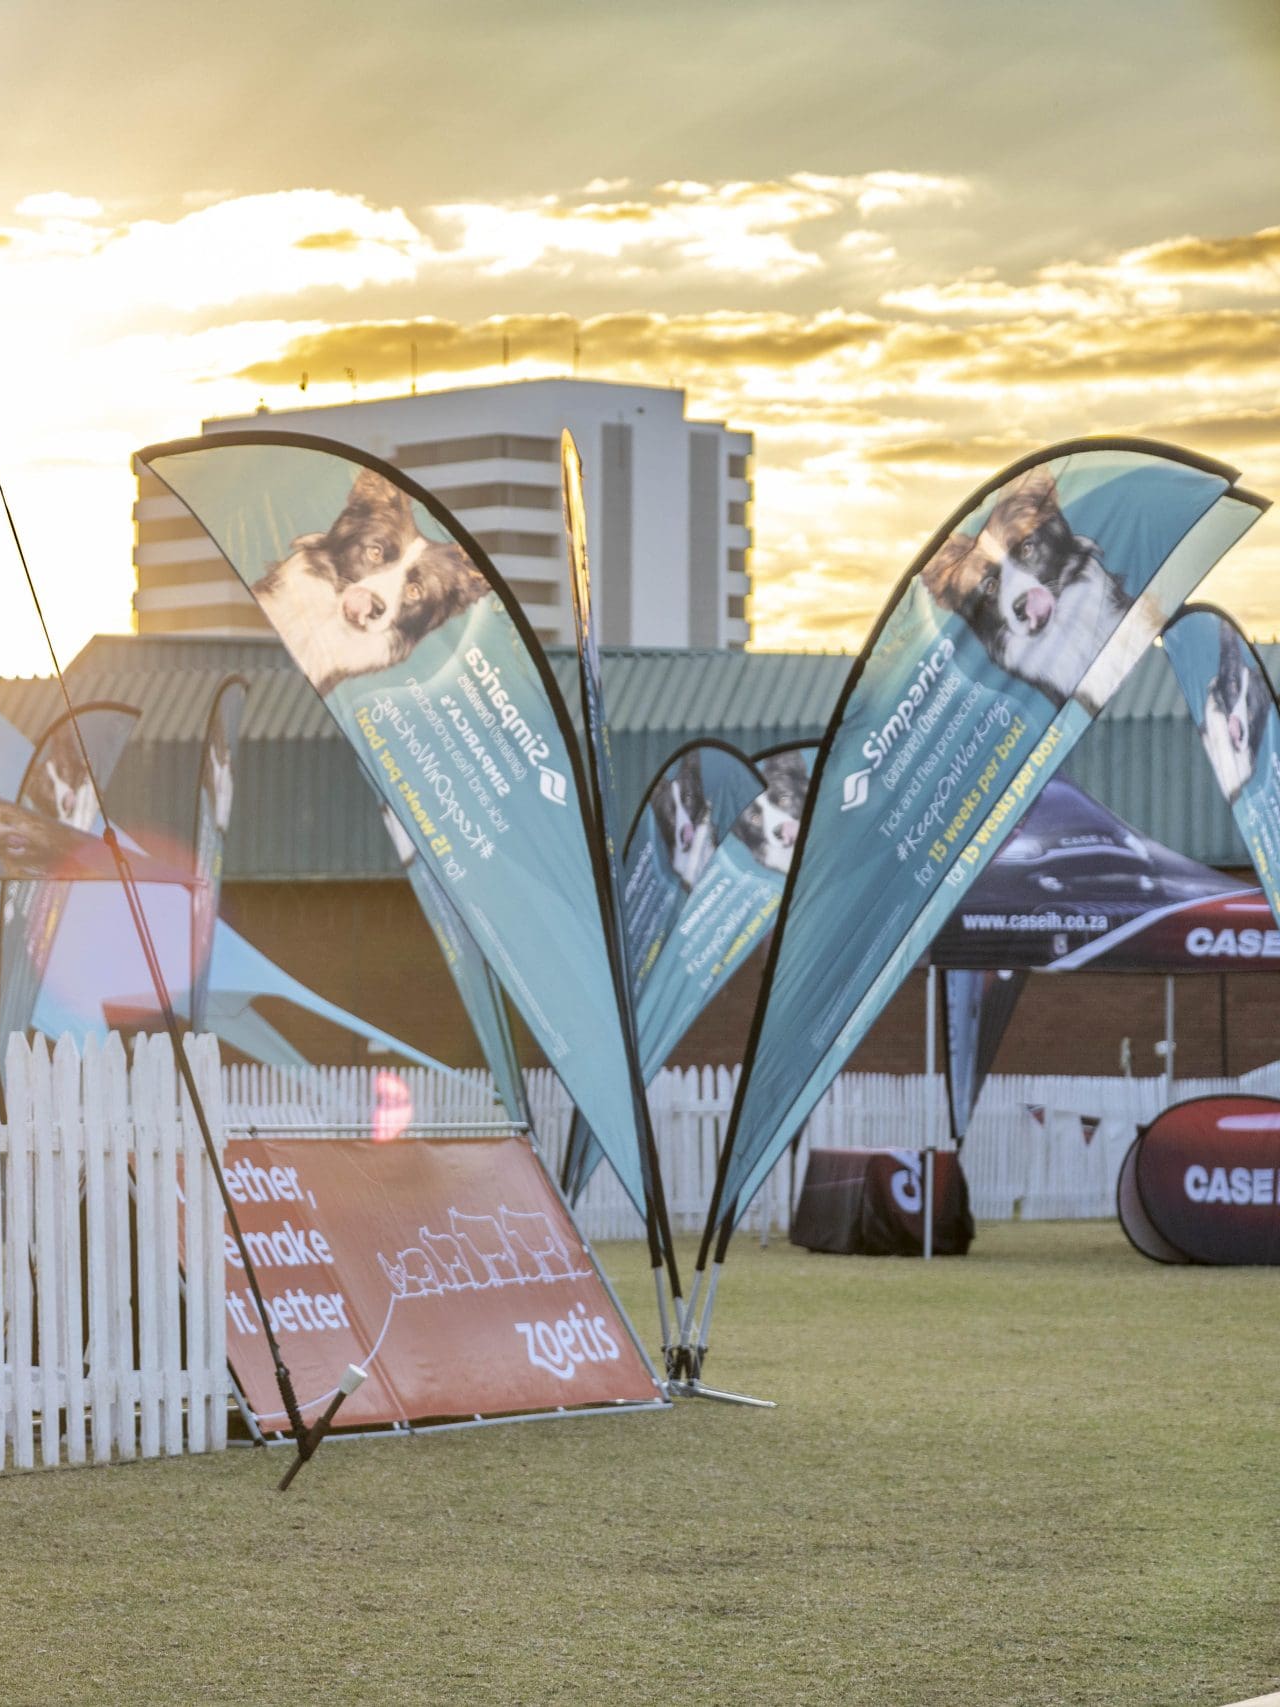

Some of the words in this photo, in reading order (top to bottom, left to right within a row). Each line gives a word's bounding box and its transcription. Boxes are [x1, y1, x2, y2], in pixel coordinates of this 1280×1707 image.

[862, 637, 955, 769] Simparica
[919, 671, 961, 735] Chewables
[879, 806, 904, 838] Tick
[901, 782, 922, 812] and
[918, 753, 940, 788] flea
[936, 681, 985, 760] protection
[896, 700, 1009, 862] #KeepsOnWorking
[974, 791, 1017, 846] weeks
[1011, 764, 1038, 800] per
[1029, 723, 1065, 769] box!
[913, 861, 937, 889] for
[927, 840, 948, 864] 15
[943, 788, 982, 845] weeks
[977, 760, 1000, 795] per
[994, 714, 1028, 761] box!
[962, 911, 1109, 931] www.caseih.co.za
[223, 1157, 317, 1209] ether,
[1183, 1164, 1274, 1206] CASE
[240, 1219, 334, 1268] make
[515, 1301, 619, 1380] zoetis
